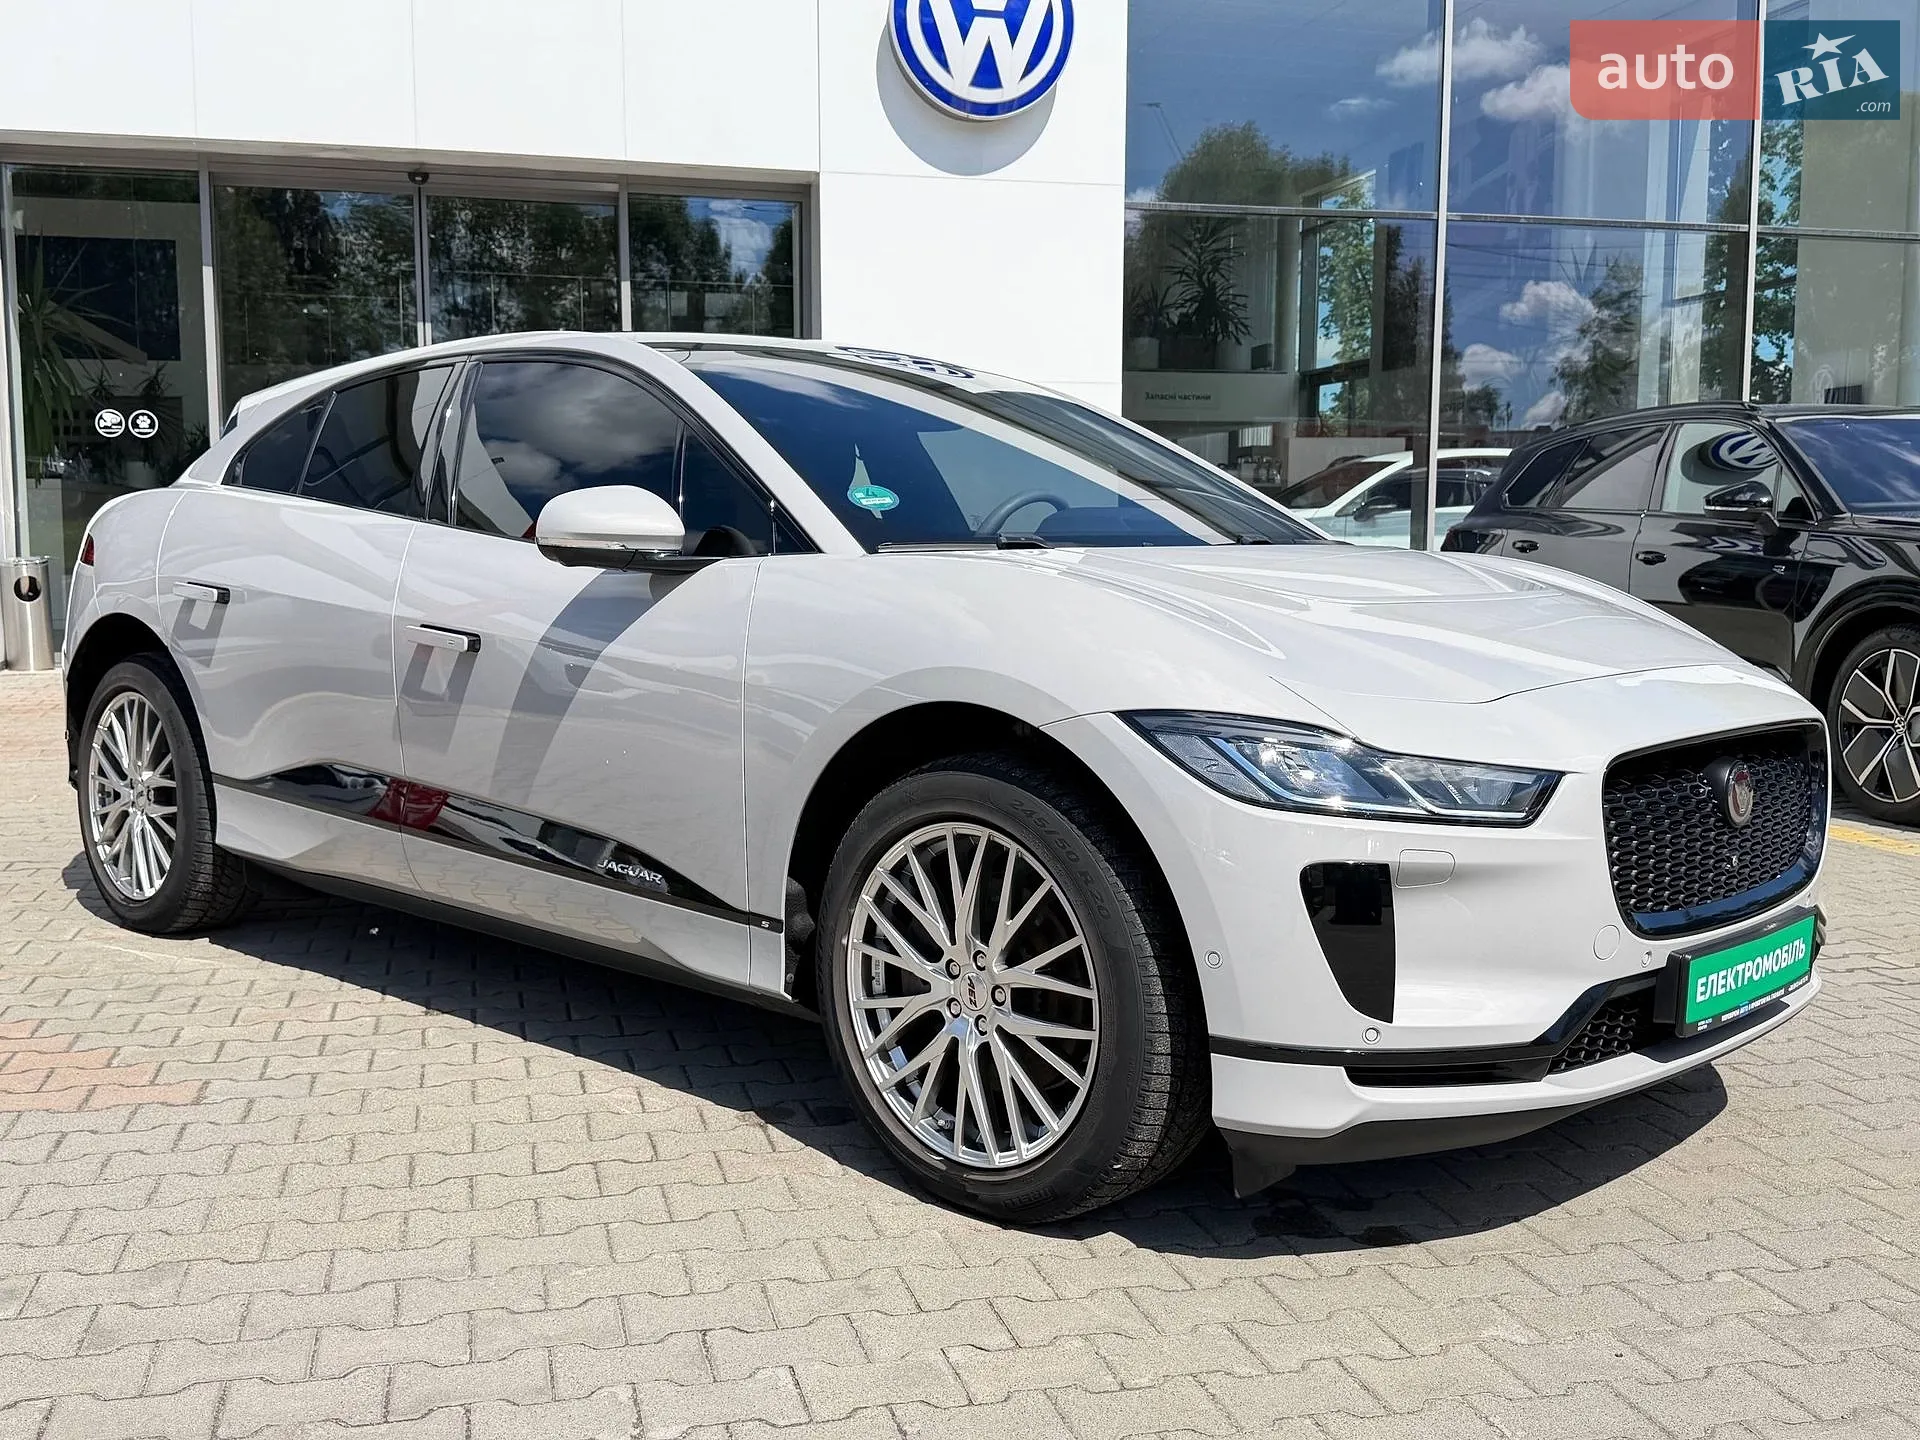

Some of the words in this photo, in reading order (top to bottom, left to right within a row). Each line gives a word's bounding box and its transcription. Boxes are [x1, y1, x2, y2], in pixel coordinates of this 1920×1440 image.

[1145, 391, 1177, 401] Запасні
[1178, 393, 1212, 402] частини
[597, 858, 665, 885] JAGUAR
[761, 920, 771, 929] S
[1695, 937, 1806, 1004] ЕЛЕКТРОМОБІЛЬ
